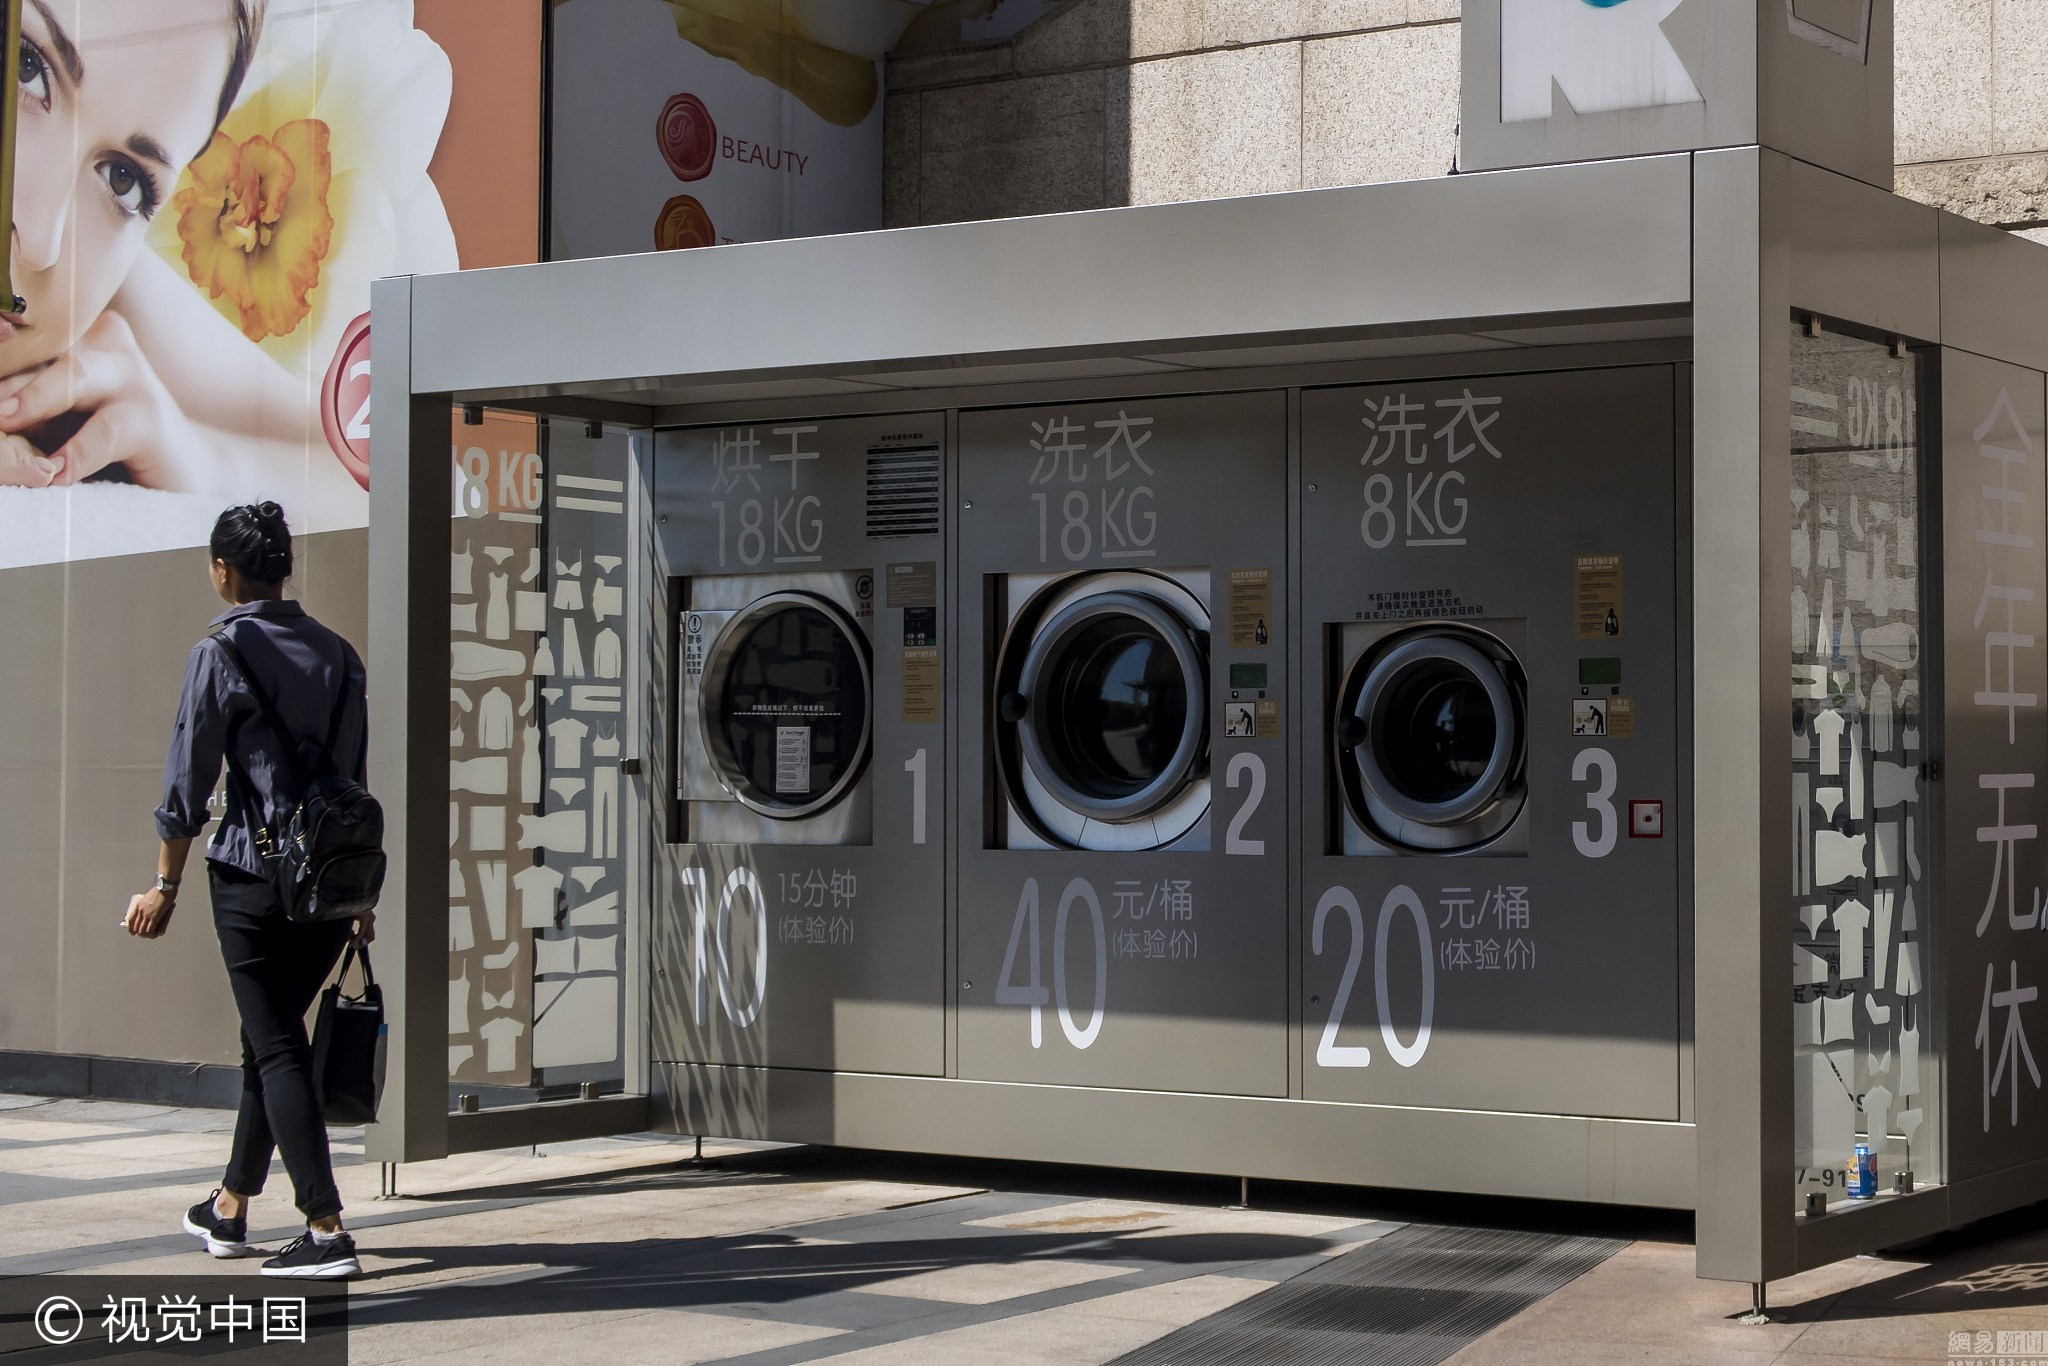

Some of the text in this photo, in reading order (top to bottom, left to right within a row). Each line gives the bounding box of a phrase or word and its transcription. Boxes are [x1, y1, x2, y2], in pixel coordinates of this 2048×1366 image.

[721, 135, 809, 176] BEAUTY
[711, 425, 820, 493] 烘干
[1029, 410, 1154, 485] 洗衣
[1360, 388, 1502, 466] 洗衣
[1367, 588, 1452, 602] 本机门顺时针旋转开启
[1973, 384, 2042, 1133] 全年无休
[904, 748, 927, 845] 1
[1225, 752, 1267, 856] 2
[1571, 747, 1618, 858] 3
[778, 868, 857, 909] 15分钟
[1112, 878, 1193, 922] 元/桶
[1439, 884, 1530, 930] 元/桶
[682, 866, 768, 1028] 10
[778, 914, 854, 945] (体验价)
[995, 876, 1107, 1050] 40
[1112, 928, 1198, 960] (体验价)
[1440, 937, 1536, 971] (体验价)
[1312, 884, 1435, 1068] 20
